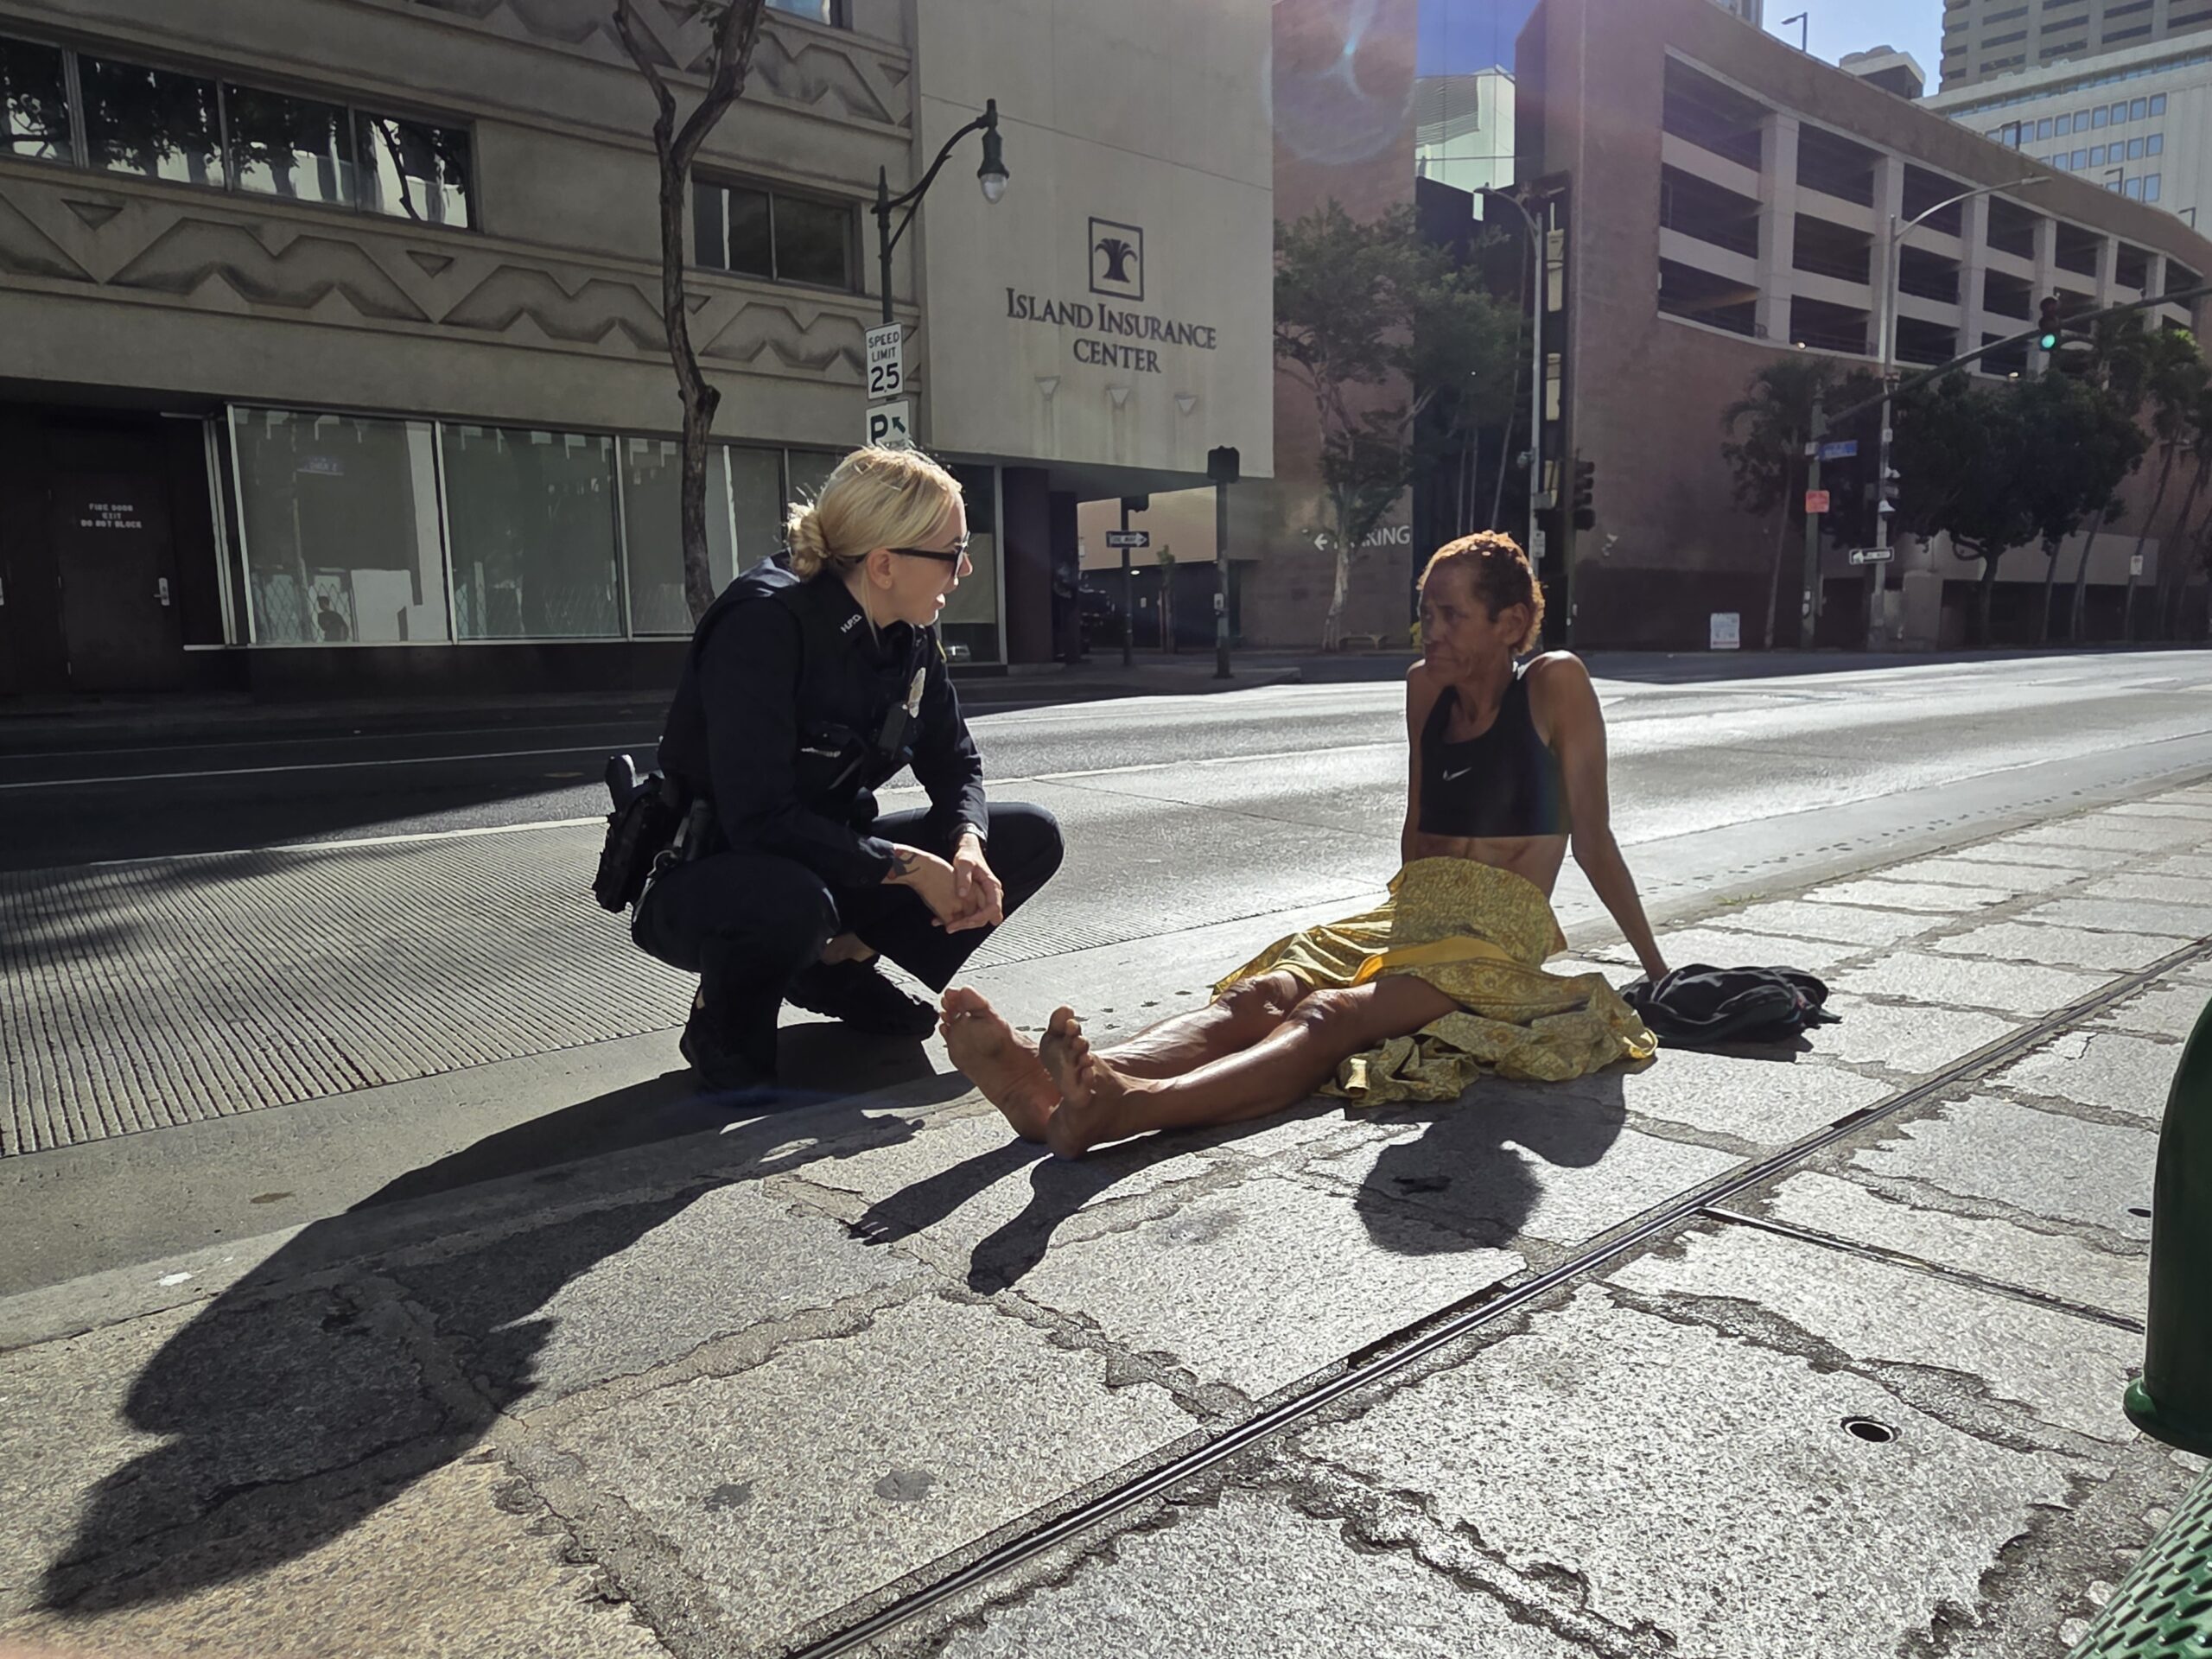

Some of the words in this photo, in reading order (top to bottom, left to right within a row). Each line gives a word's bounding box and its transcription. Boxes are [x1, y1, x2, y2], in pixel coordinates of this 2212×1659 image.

[1006, 288, 1094, 328] ISLAND
[1098, 303, 1217, 350] INSURANCE
[868, 331, 899, 348] SPEED
[871, 346, 896, 362] LIMIT
[1073, 338, 1161, 373] CENTER
[871, 363, 899, 392] 25
[871, 414, 888, 446] P
